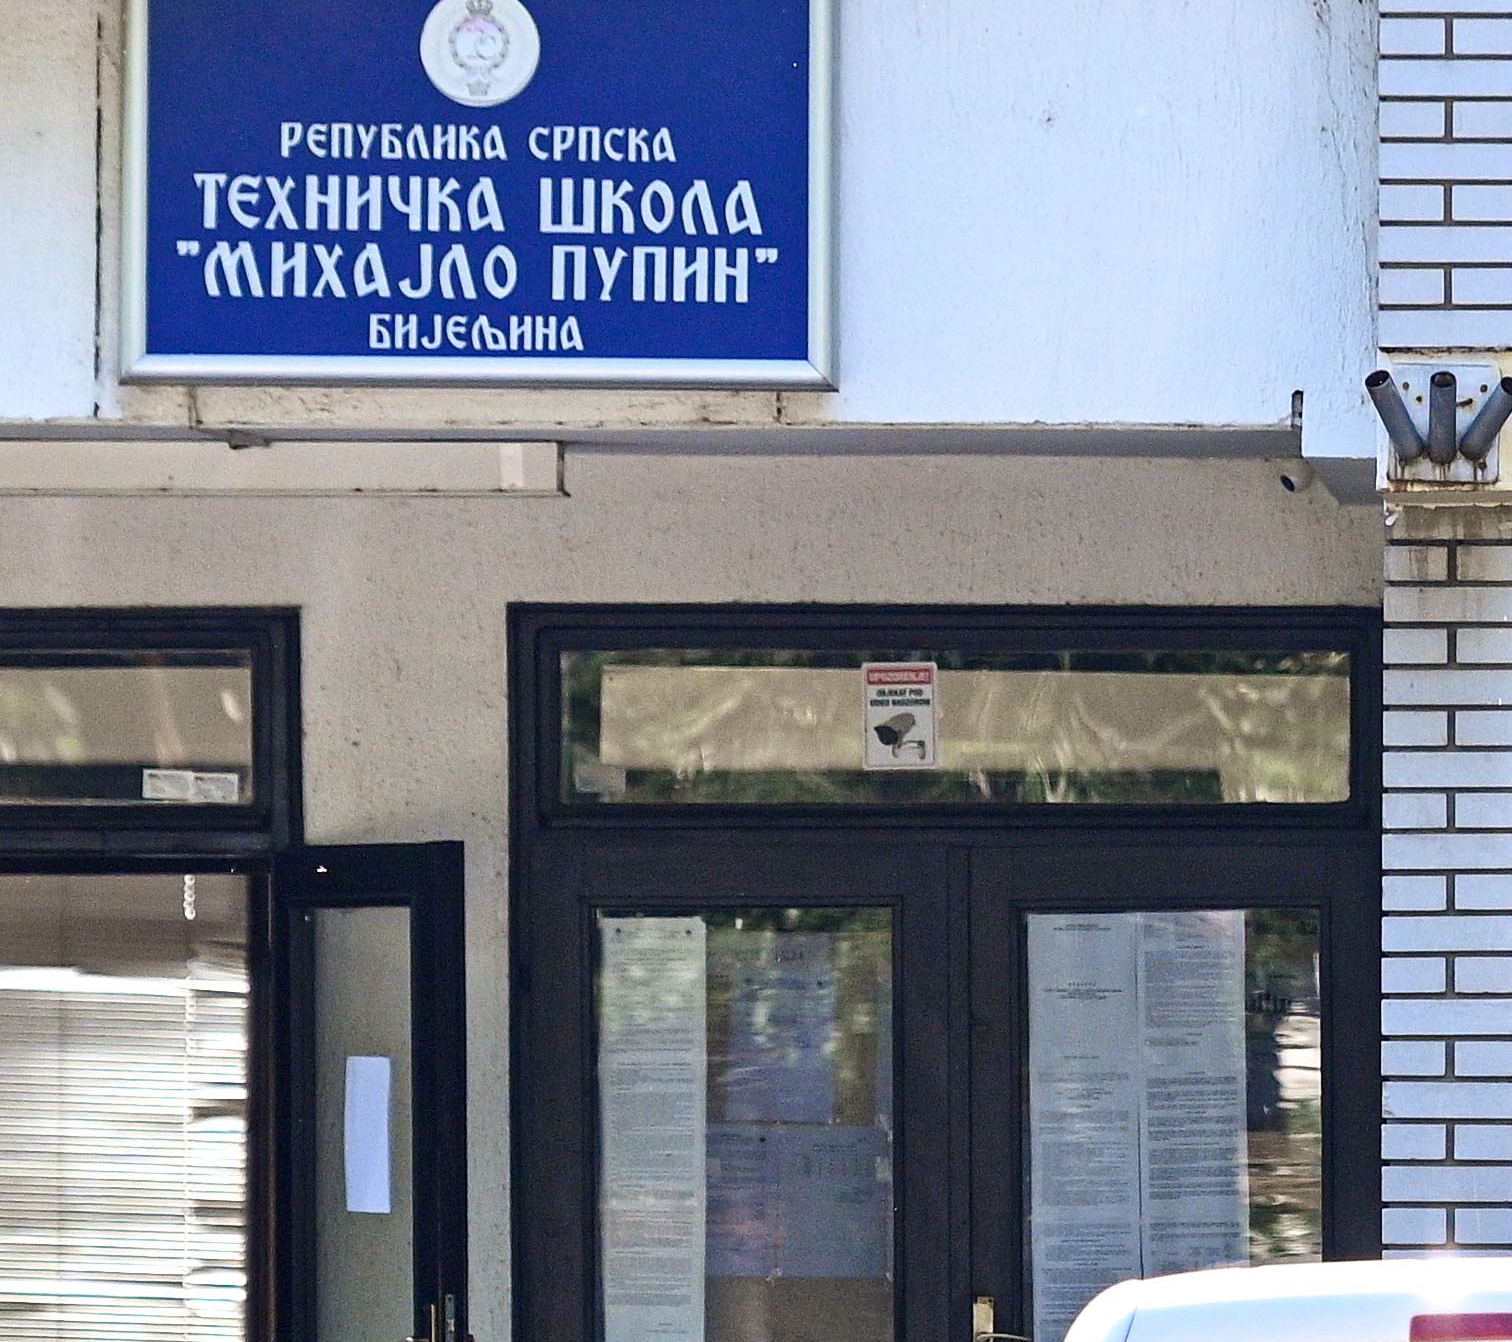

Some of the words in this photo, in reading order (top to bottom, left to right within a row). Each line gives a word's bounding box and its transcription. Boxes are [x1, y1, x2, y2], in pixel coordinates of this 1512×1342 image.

[280, 122, 507, 161] РЕПУБЛИКА
[528, 126, 676, 163] СРПСКА
[193, 173, 505, 232] ТЕХНИЧКА
[539, 177, 763, 236] ШКОЛА
[368, 313, 585, 351] БИЈЕЉИНА
